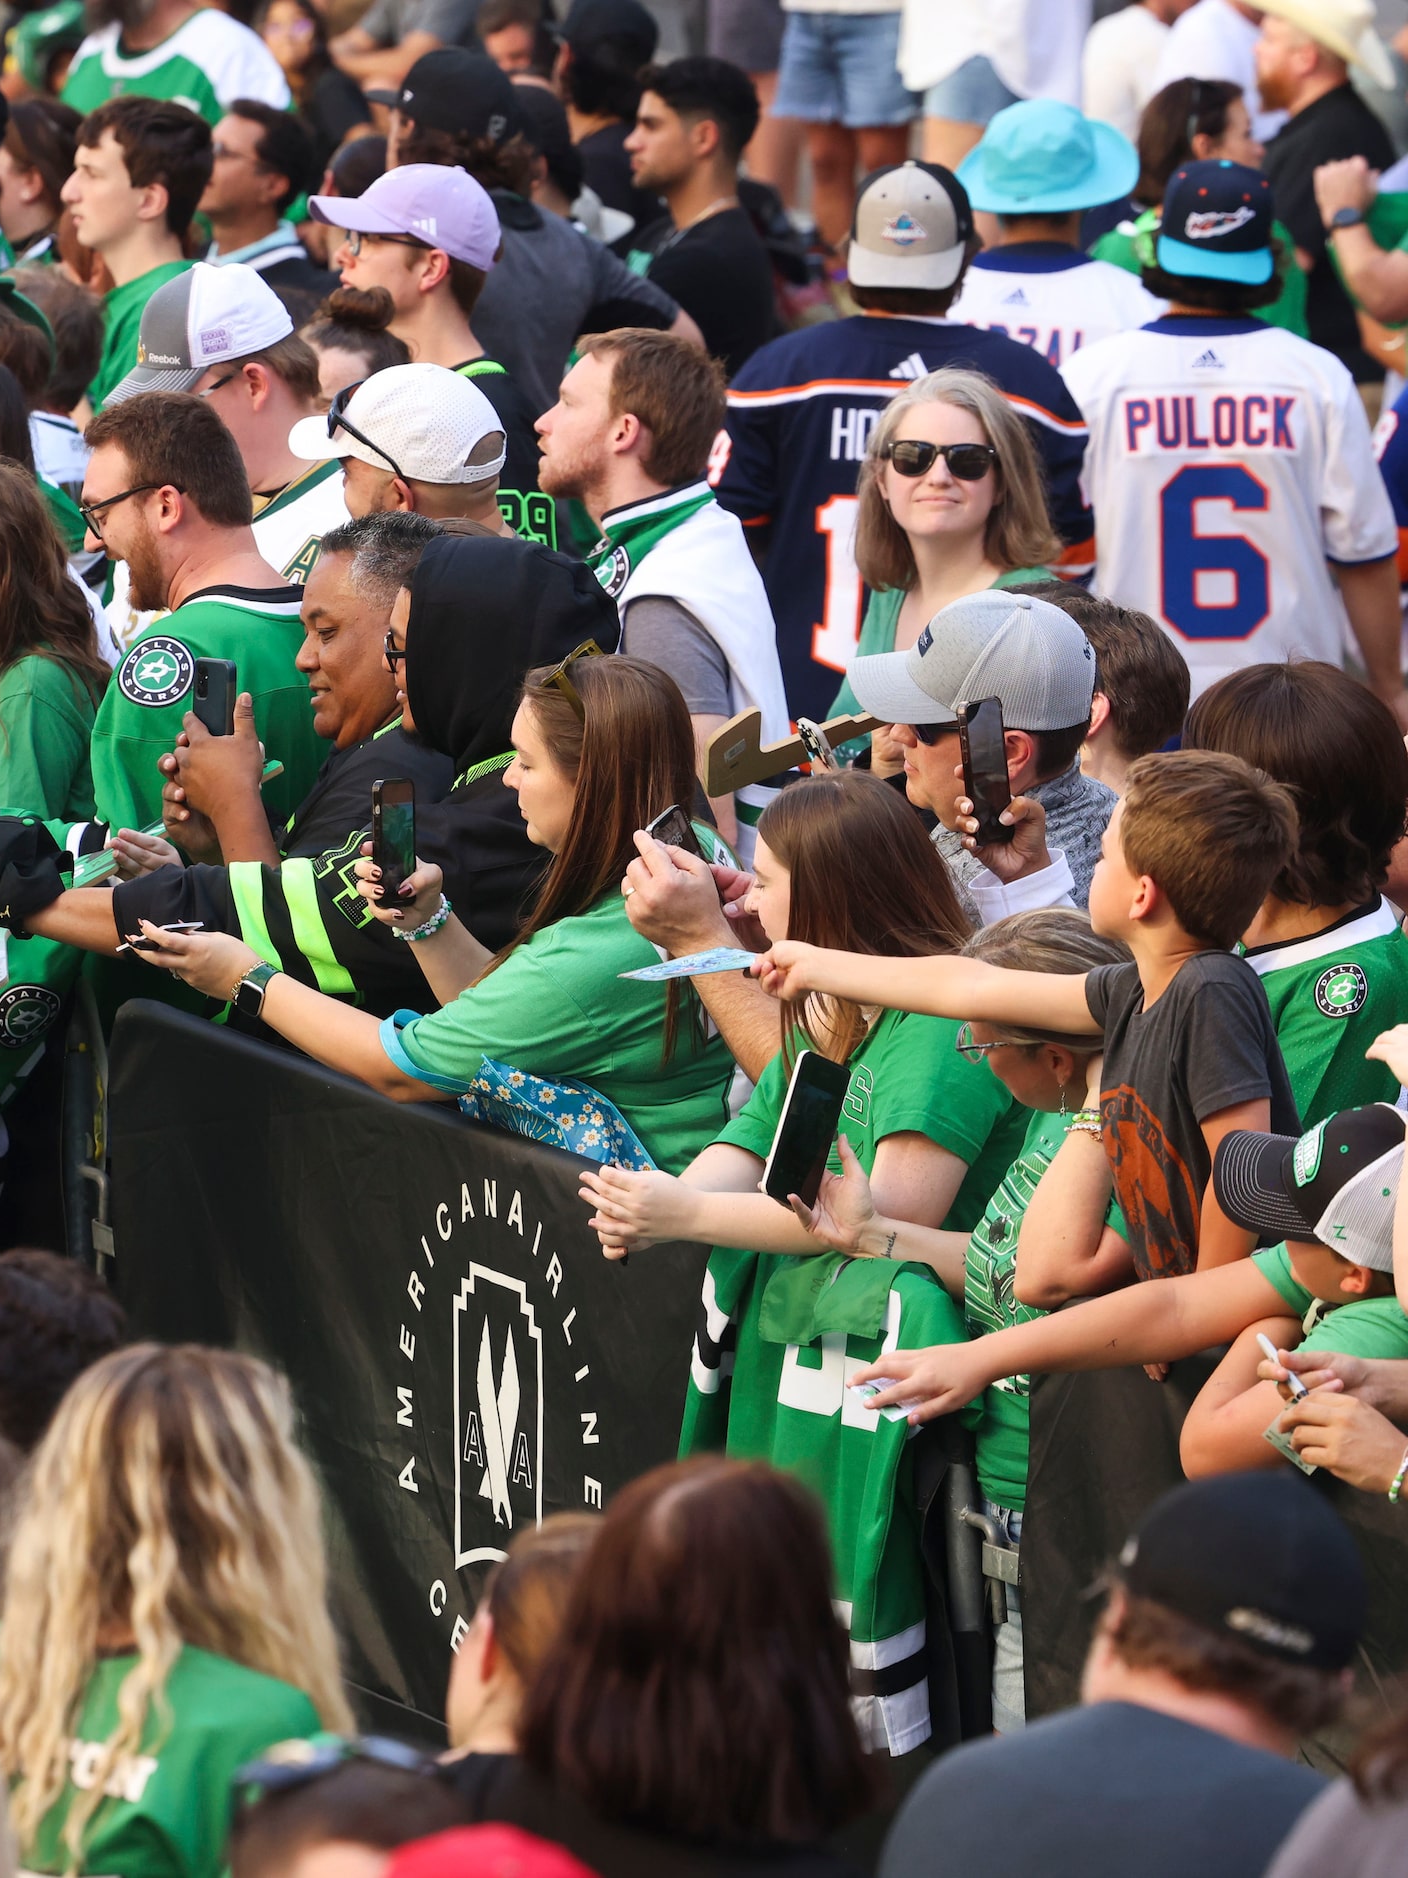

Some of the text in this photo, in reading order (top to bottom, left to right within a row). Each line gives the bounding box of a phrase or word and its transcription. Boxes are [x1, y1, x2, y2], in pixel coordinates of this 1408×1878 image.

[148, 352, 182, 365] Reebok
[1124, 395, 1297, 454] PULOCK
[1159, 461, 1271, 643] 6
[129, 641, 189, 672] DALLAS
[124, 677, 180, 701] STARS
[1320, 966, 1365, 991] DALLAS
[1320, 998, 1359, 1015] STARS
[506, 1189, 603, 1510] AIRLINE
